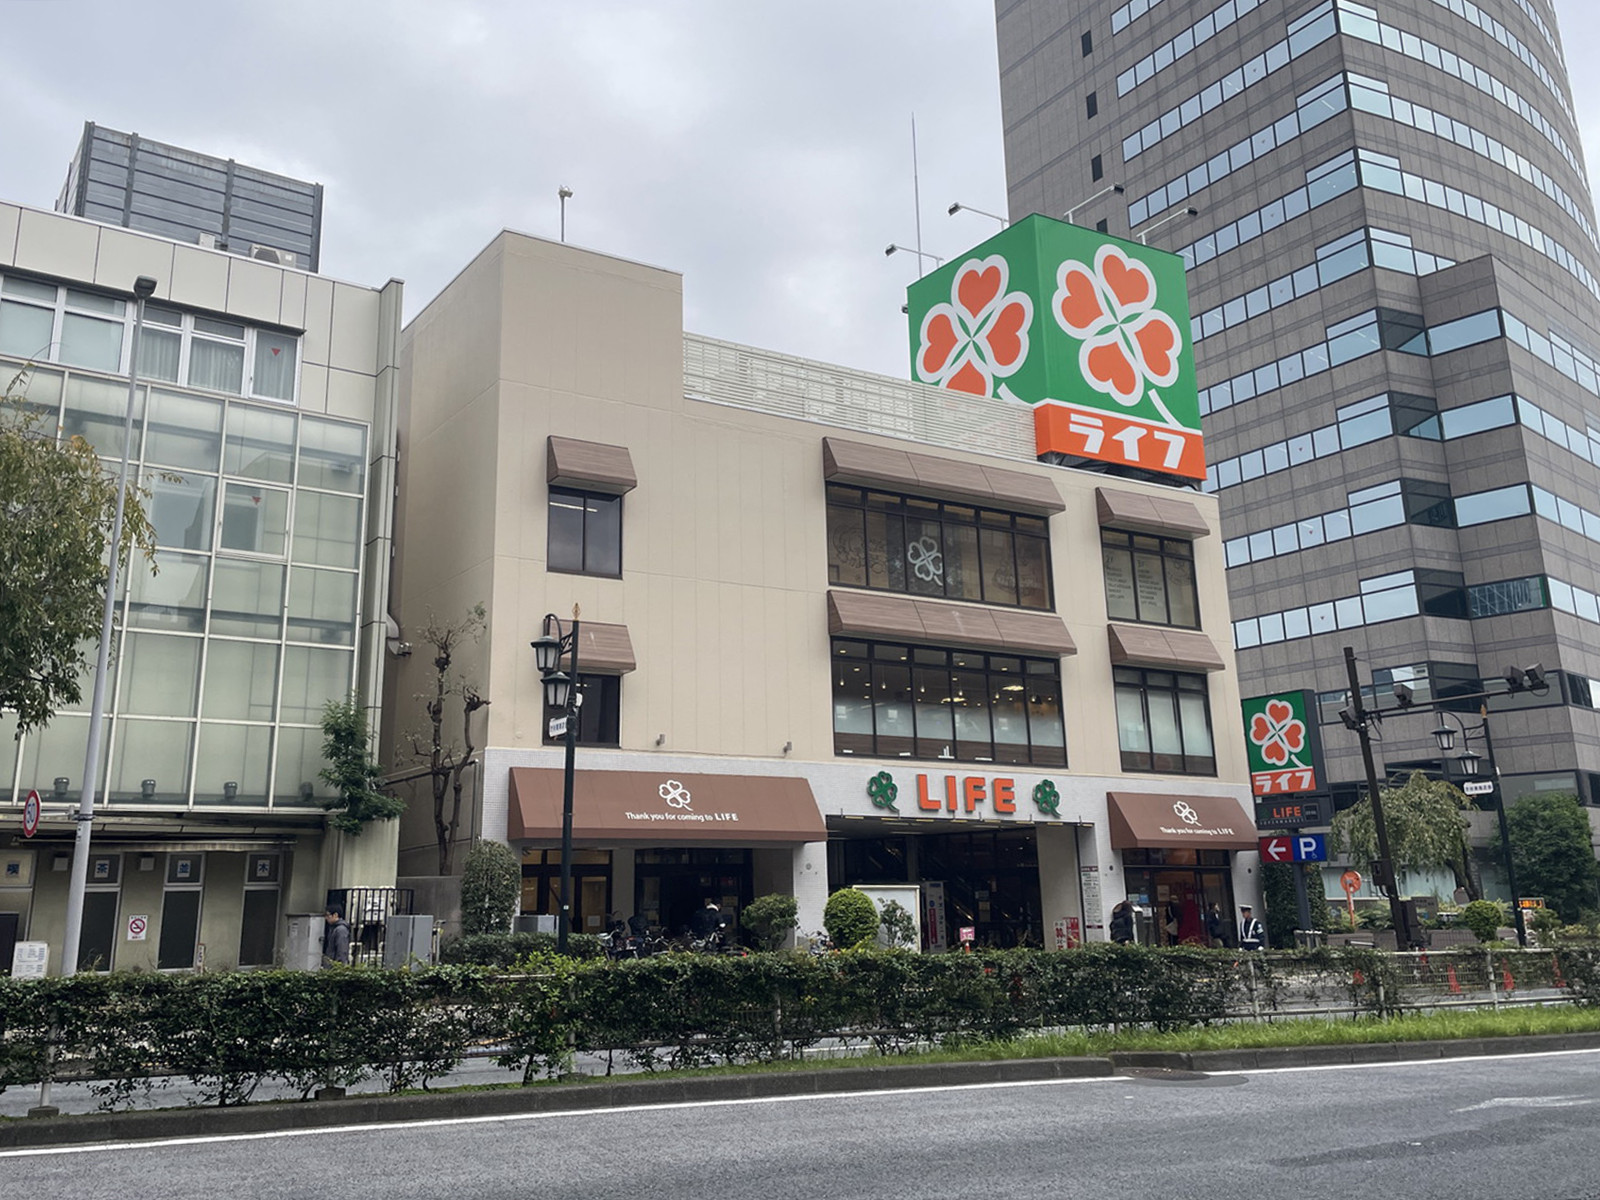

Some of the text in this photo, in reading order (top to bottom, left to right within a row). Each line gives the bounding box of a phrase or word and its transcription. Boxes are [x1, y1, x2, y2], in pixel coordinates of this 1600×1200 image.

[1069, 413, 1186, 470] ライフ
[1255, 771, 1312, 792] ライフ
[916, 774, 1016, 814] LIFE
[26, 802, 36, 824] 50
[625, 812, 650, 820] Thank
[650, 813, 665, 821] you
[677, 813, 705, 822] coming
[705, 813, 714, 821] to
[714, 813, 739, 821] LIFE
[1272, 806, 1302, 818] LIFE
[1160, 826, 1177, 834] Thank
[1298, 837, 1317, 860] P
[96, 863, 108, 873] 茶
[258, 862, 270, 872] 木
